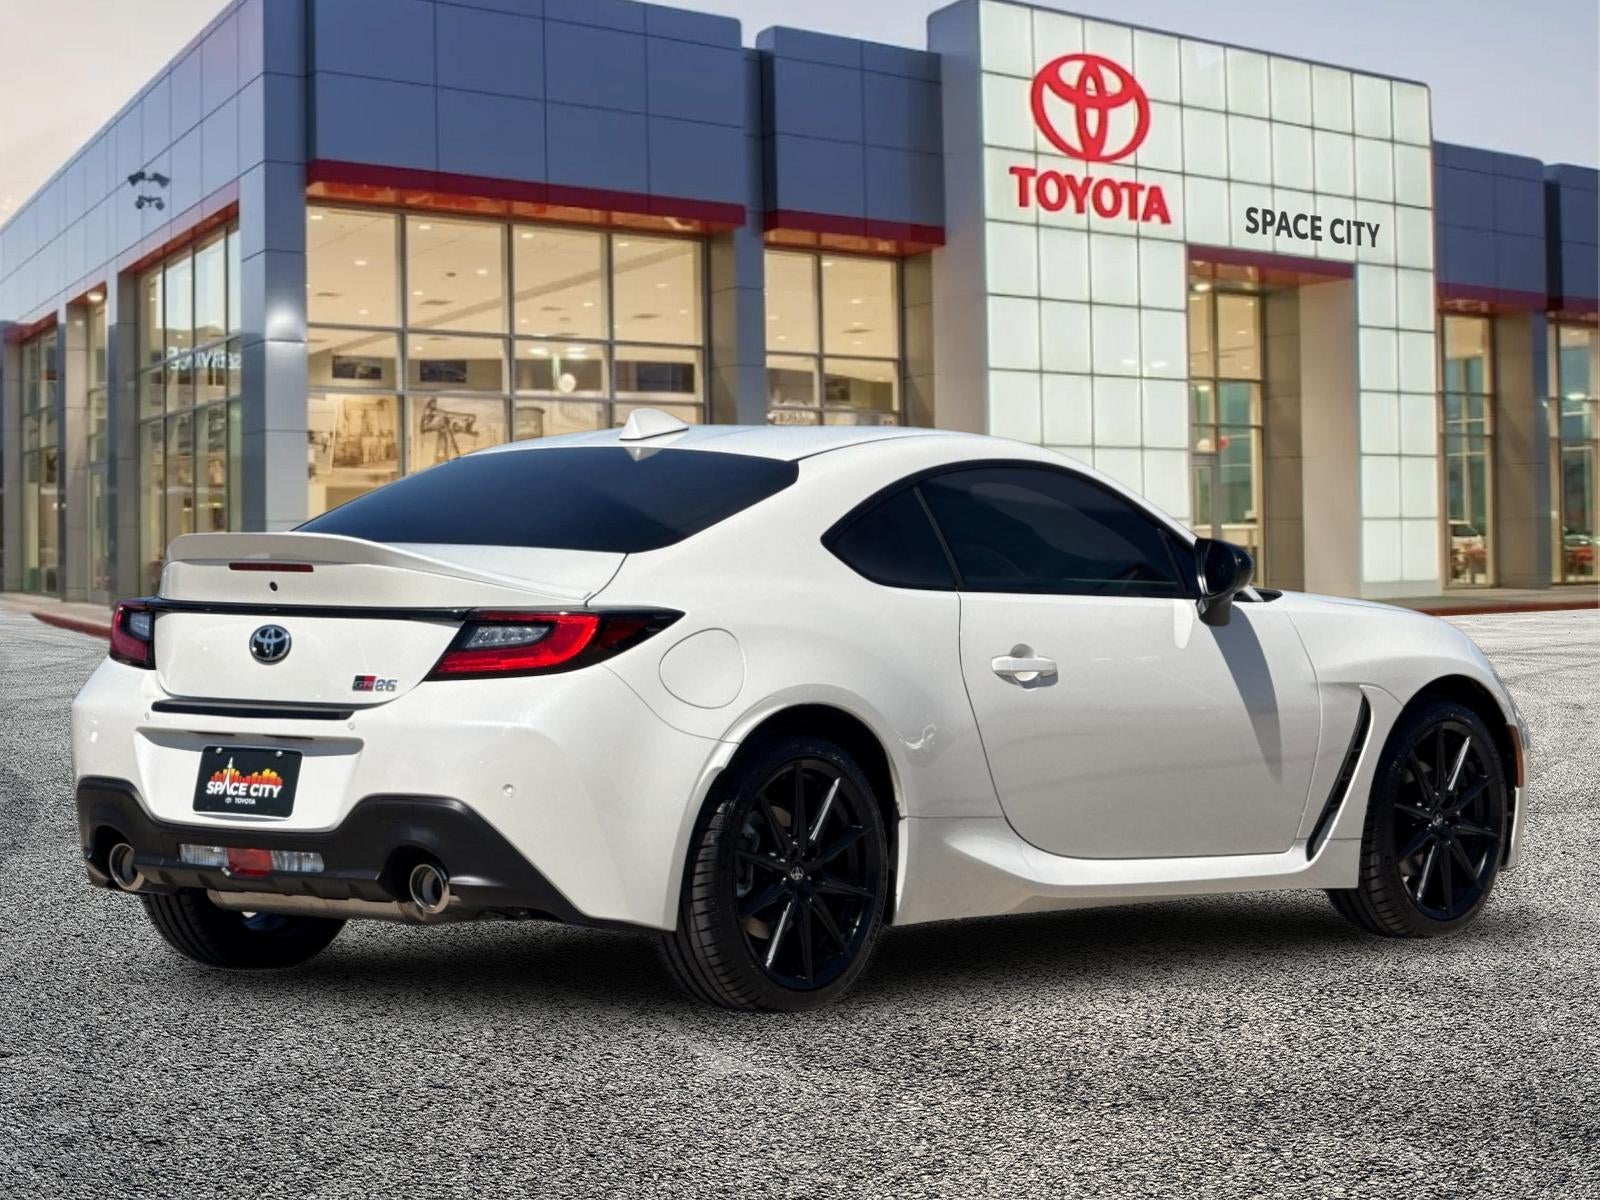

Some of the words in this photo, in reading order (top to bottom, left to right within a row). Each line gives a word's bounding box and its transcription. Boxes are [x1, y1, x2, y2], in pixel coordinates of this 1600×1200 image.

[1009, 166, 1171, 224] TOYOTA
[1245, 206, 1323, 242] SPACE
[1329, 217, 1381, 248] CITY
[206, 770, 248, 796] SPACE
[249, 783, 282, 798] CITY
[234, 797, 256, 805] TOYOTA
